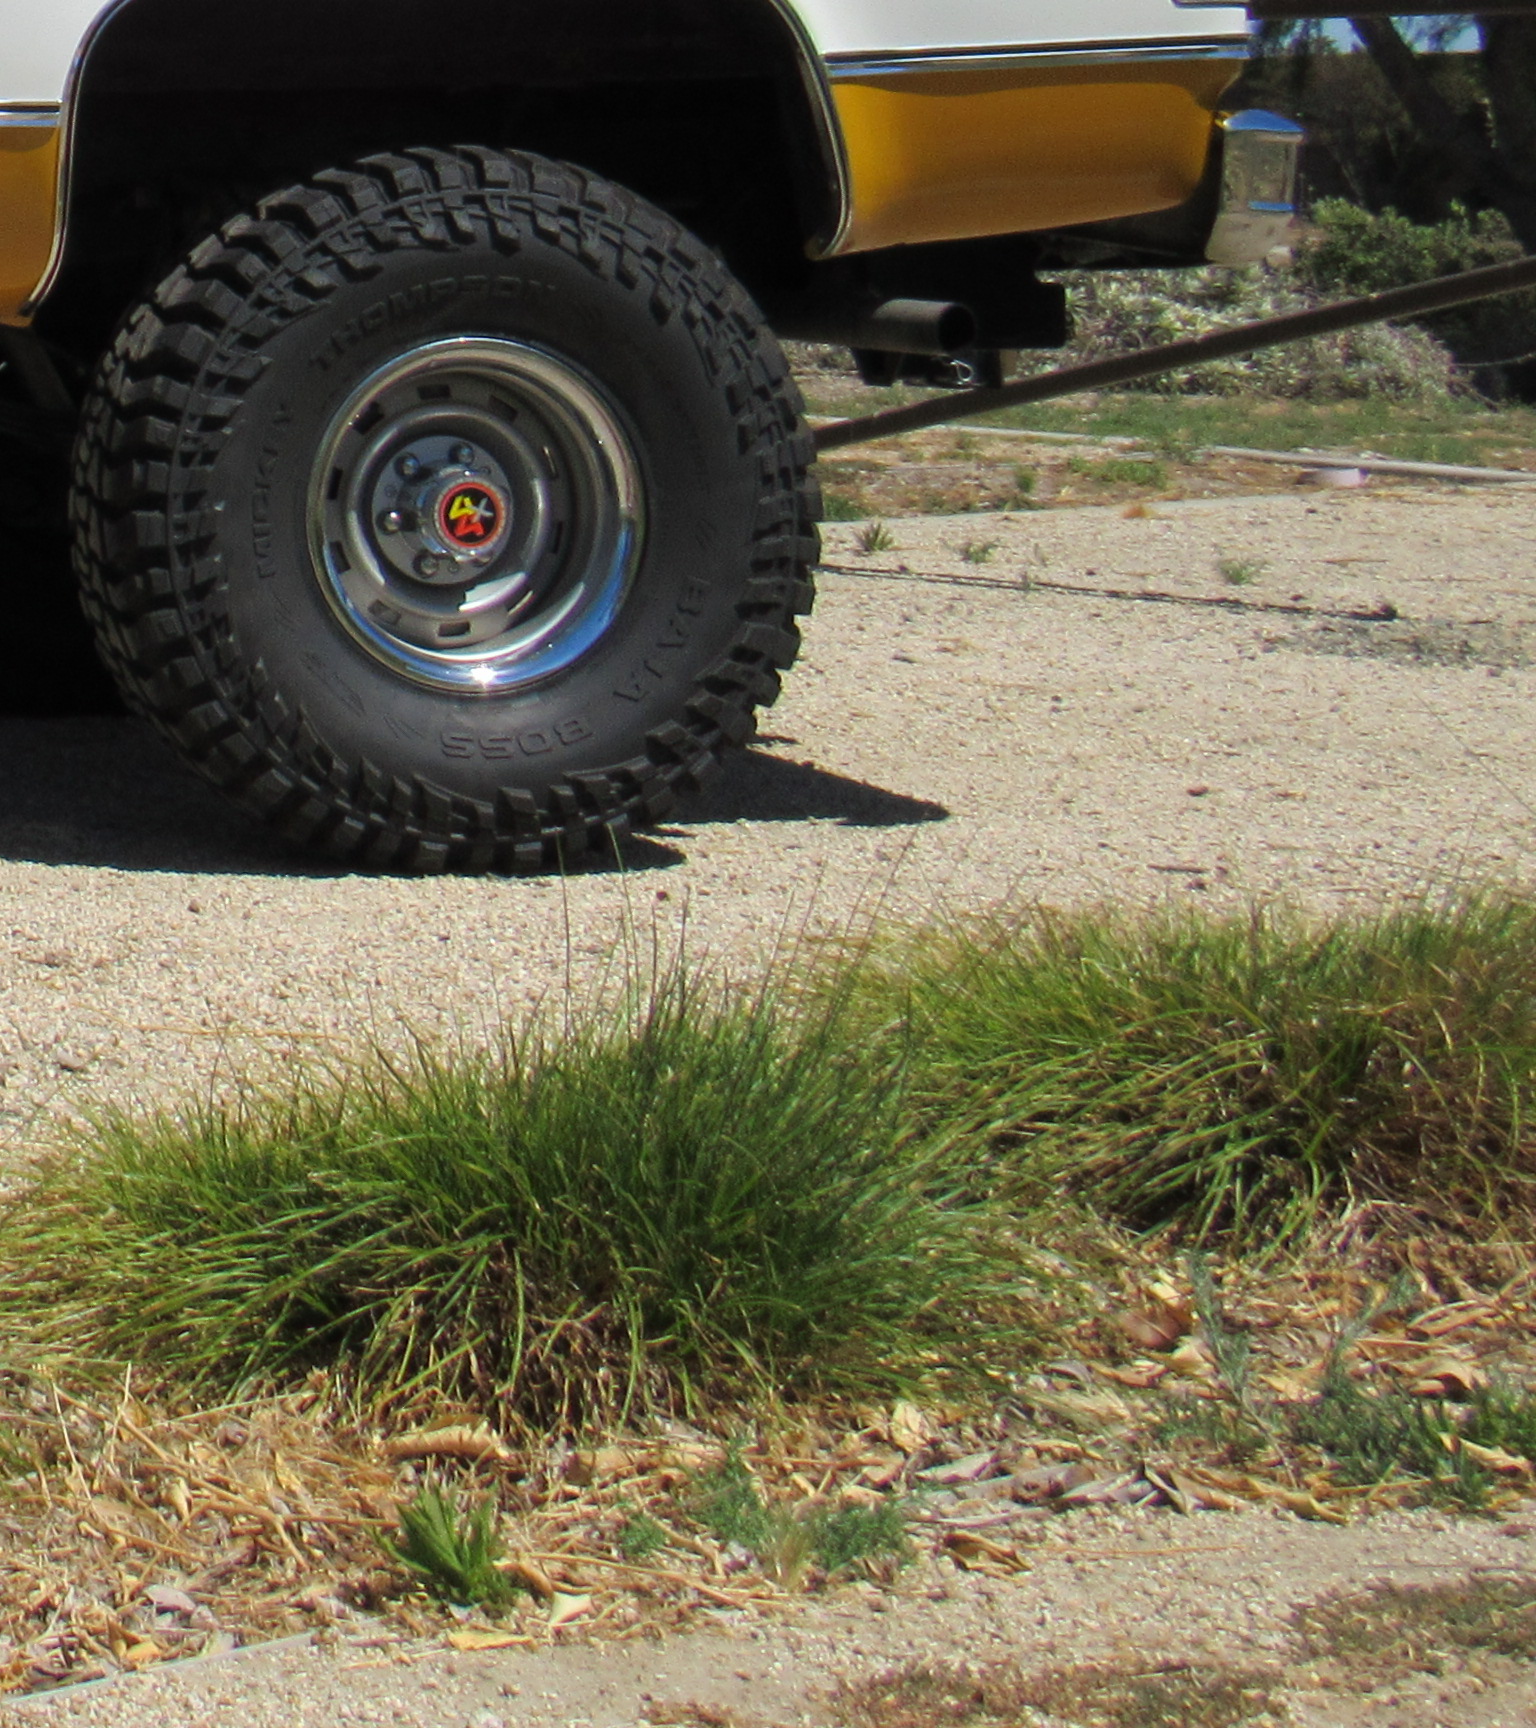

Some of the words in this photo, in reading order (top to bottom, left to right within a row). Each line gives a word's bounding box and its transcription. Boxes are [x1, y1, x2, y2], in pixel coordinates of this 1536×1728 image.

[308, 274, 558, 371] THOMPSON
[612, 574, 712, 702] BAJA
[441, 717, 593, 759] BOSS
